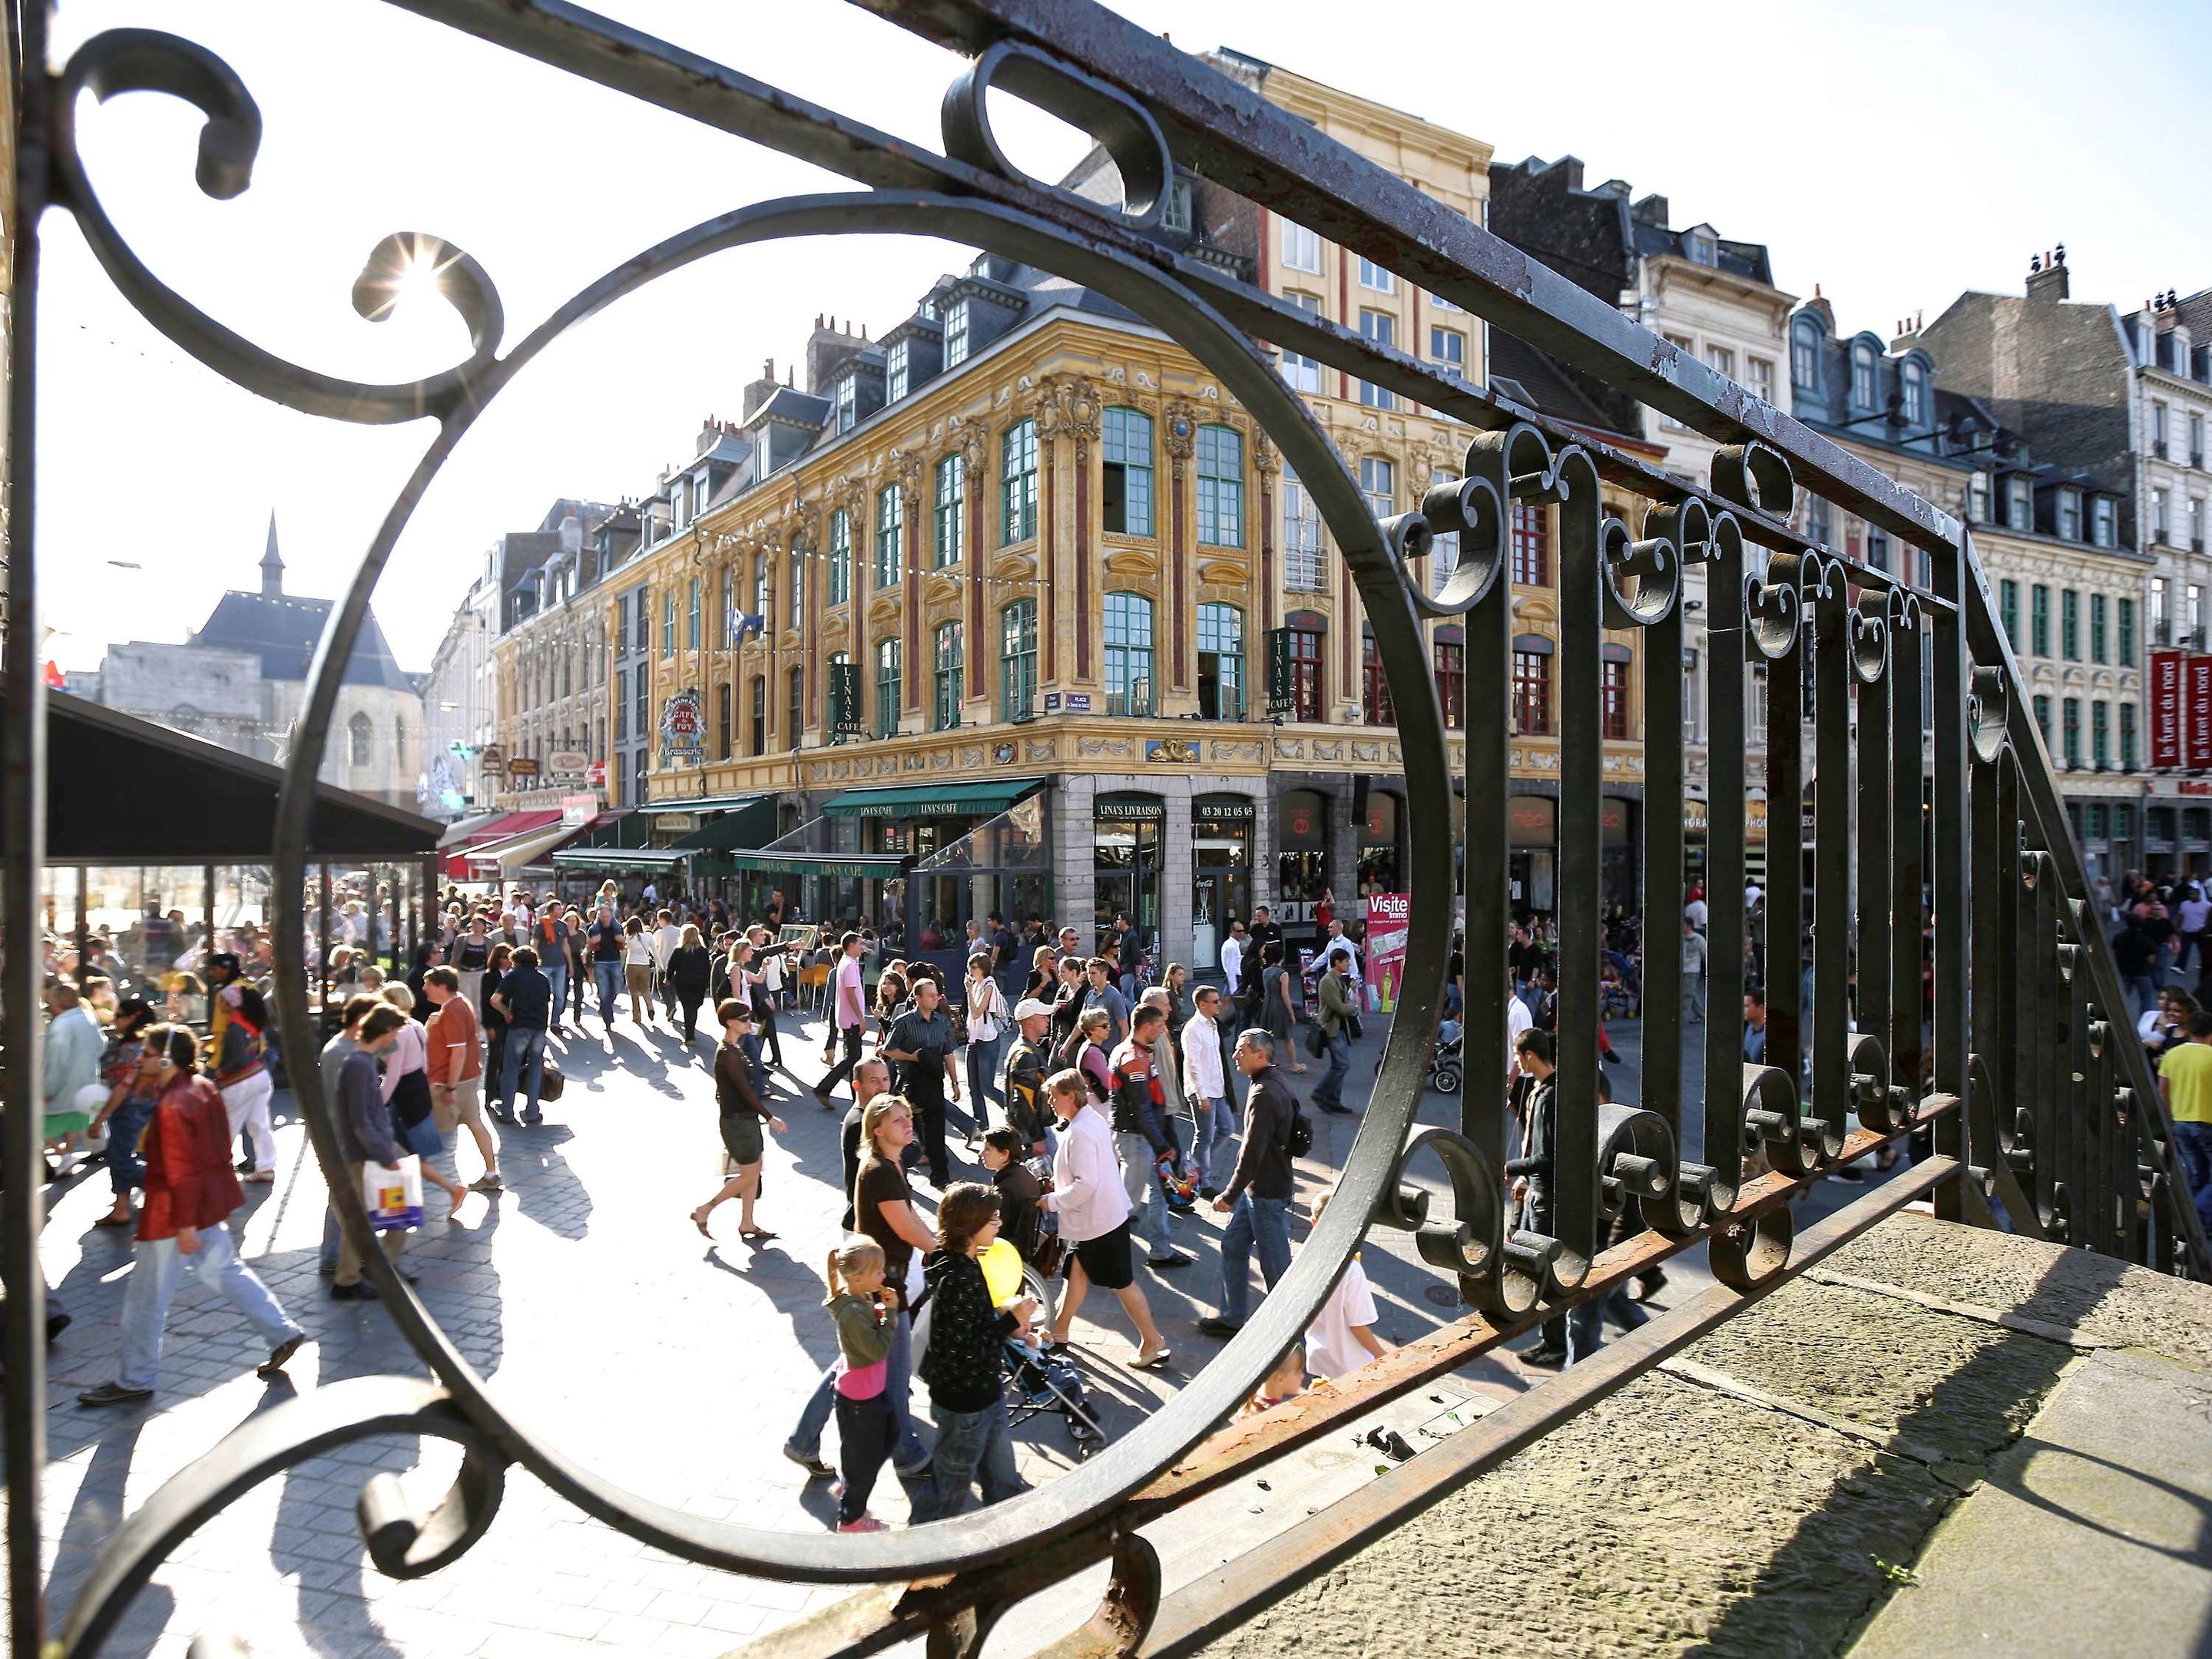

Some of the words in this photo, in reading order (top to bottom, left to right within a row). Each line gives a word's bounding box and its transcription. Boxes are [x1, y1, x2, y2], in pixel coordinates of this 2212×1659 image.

[2159, 661, 2175, 690] nord
[2194, 667, 2209, 694] nord
[2159, 694, 2175, 710] du
[2194, 698, 2209, 713] du
[2157, 714, 2175, 743] furet
[2191, 717, 2209, 745] furet
[2159, 746, 2175, 757] le
[2194, 748, 2210, 760] le
[1101, 805, 1123, 815] LINA'S
[1124, 806, 1162, 816] LIVRAISON
[1202, 806, 1211, 816] 03
[1214, 806, 1222, 816] 20
[1224, 807, 1232, 816] 12
[1233, 807, 1243, 816] 05
[1244, 806, 1253, 816] 05
[1370, 896, 1408, 913] Visite
